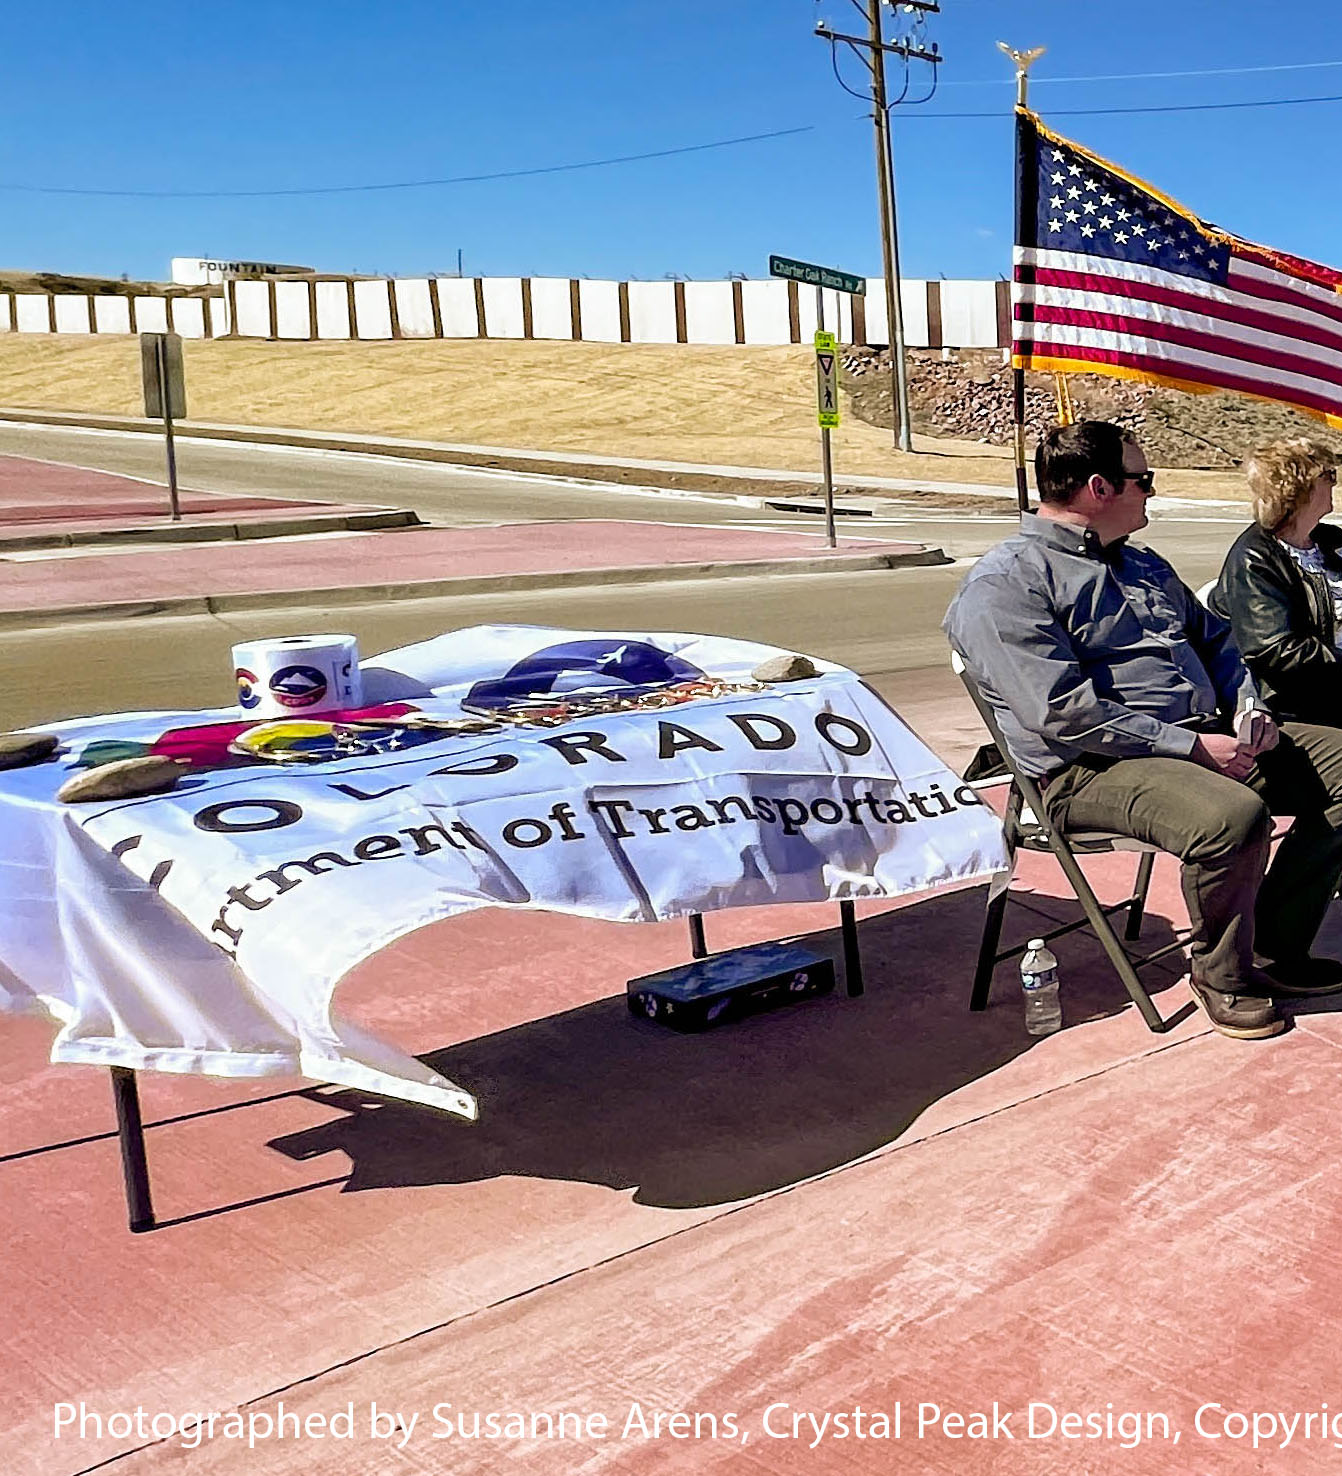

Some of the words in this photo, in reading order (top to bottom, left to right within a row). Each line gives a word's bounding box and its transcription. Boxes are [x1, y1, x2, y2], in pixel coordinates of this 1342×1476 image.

[199, 261, 277, 273] FOUNTAIN
[502, 802, 585, 849] of
[589, 784, 983, 839] Transportatio
